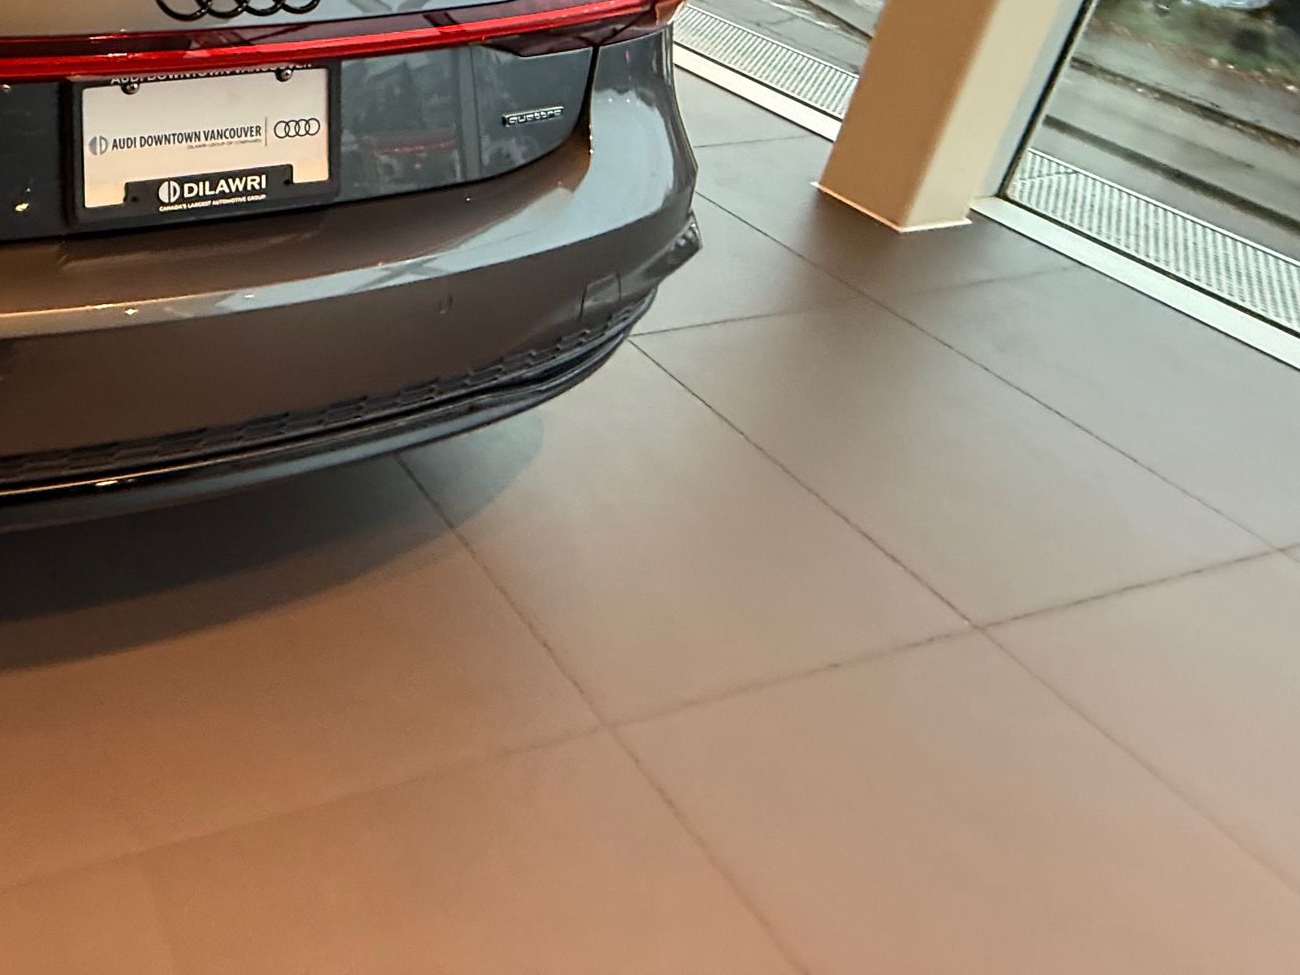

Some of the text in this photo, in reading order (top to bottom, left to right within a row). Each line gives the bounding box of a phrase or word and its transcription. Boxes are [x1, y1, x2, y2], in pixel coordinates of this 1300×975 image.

[111, 125, 262, 151] AUDI DOWNTOWN VANCOUVER
[184, 175, 267, 198] DILAWRI
